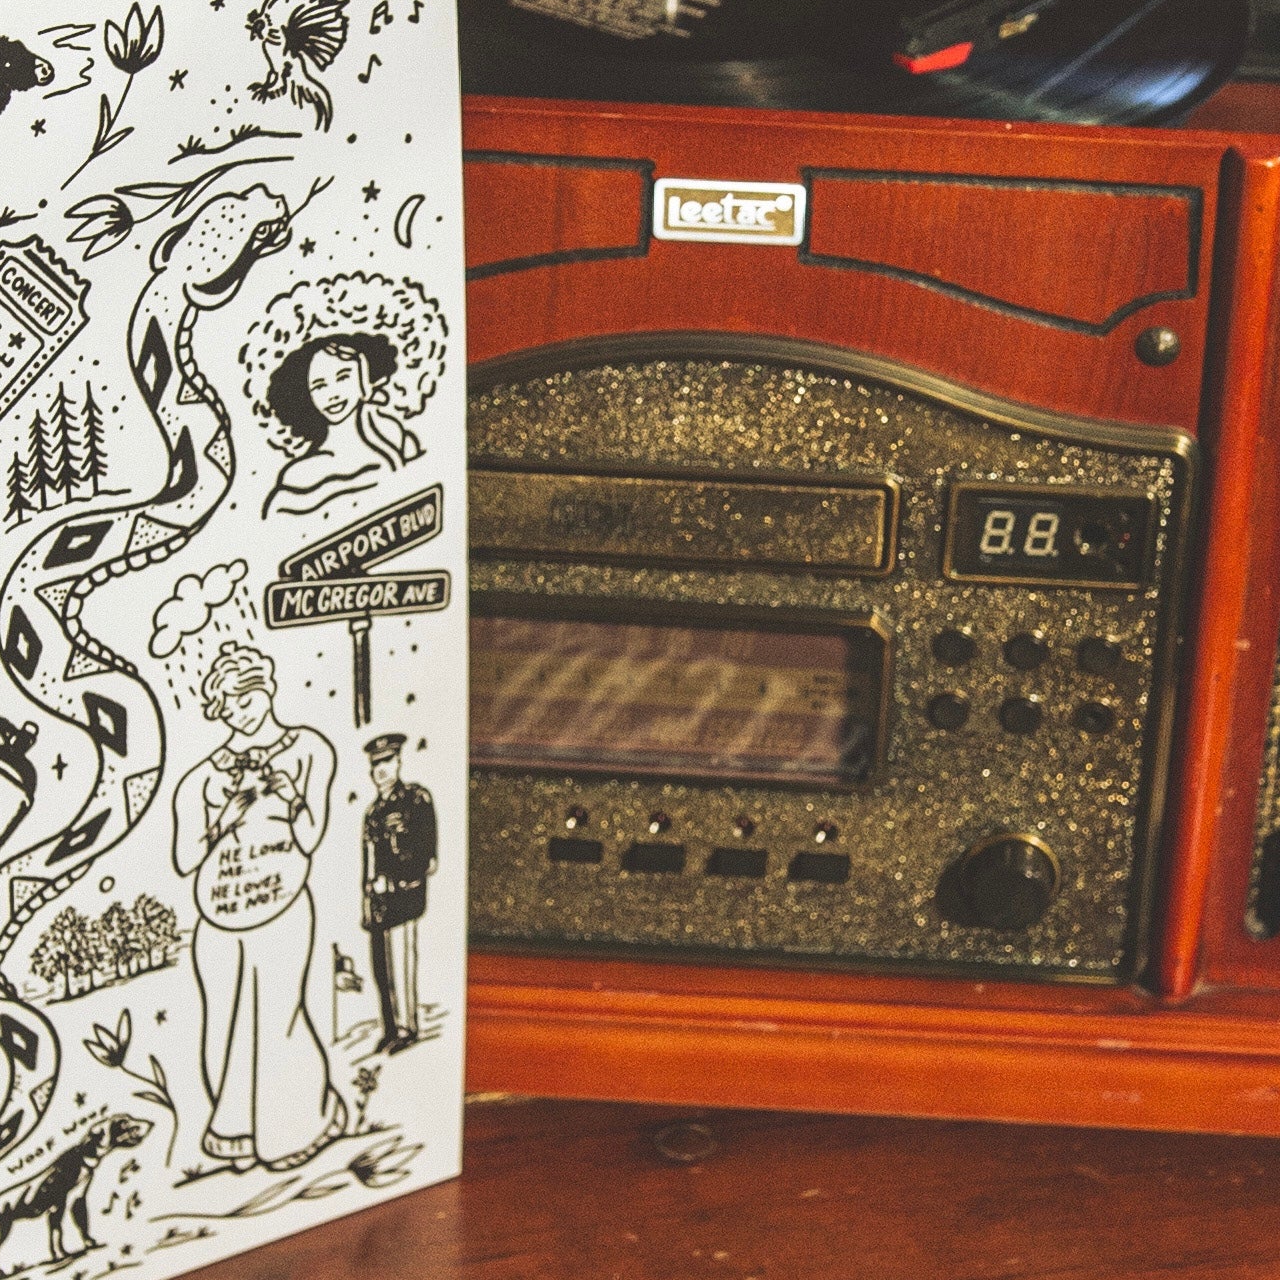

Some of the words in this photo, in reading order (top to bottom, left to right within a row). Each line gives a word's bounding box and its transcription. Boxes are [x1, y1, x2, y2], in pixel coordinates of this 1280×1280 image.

[1, 267, 65, 326] CONCERT
[301, 516, 397, 582] AIRPORT
[399, 503, 436, 538] BLVD
[280, 589, 315, 618] MC
[317, 581, 398, 613] GREGOR
[402, 581, 439, 604] AVE
[218, 847, 242, 865] HE
[210, 883, 229, 902] HE
[7, 1138, 55, 1174] WOOF
